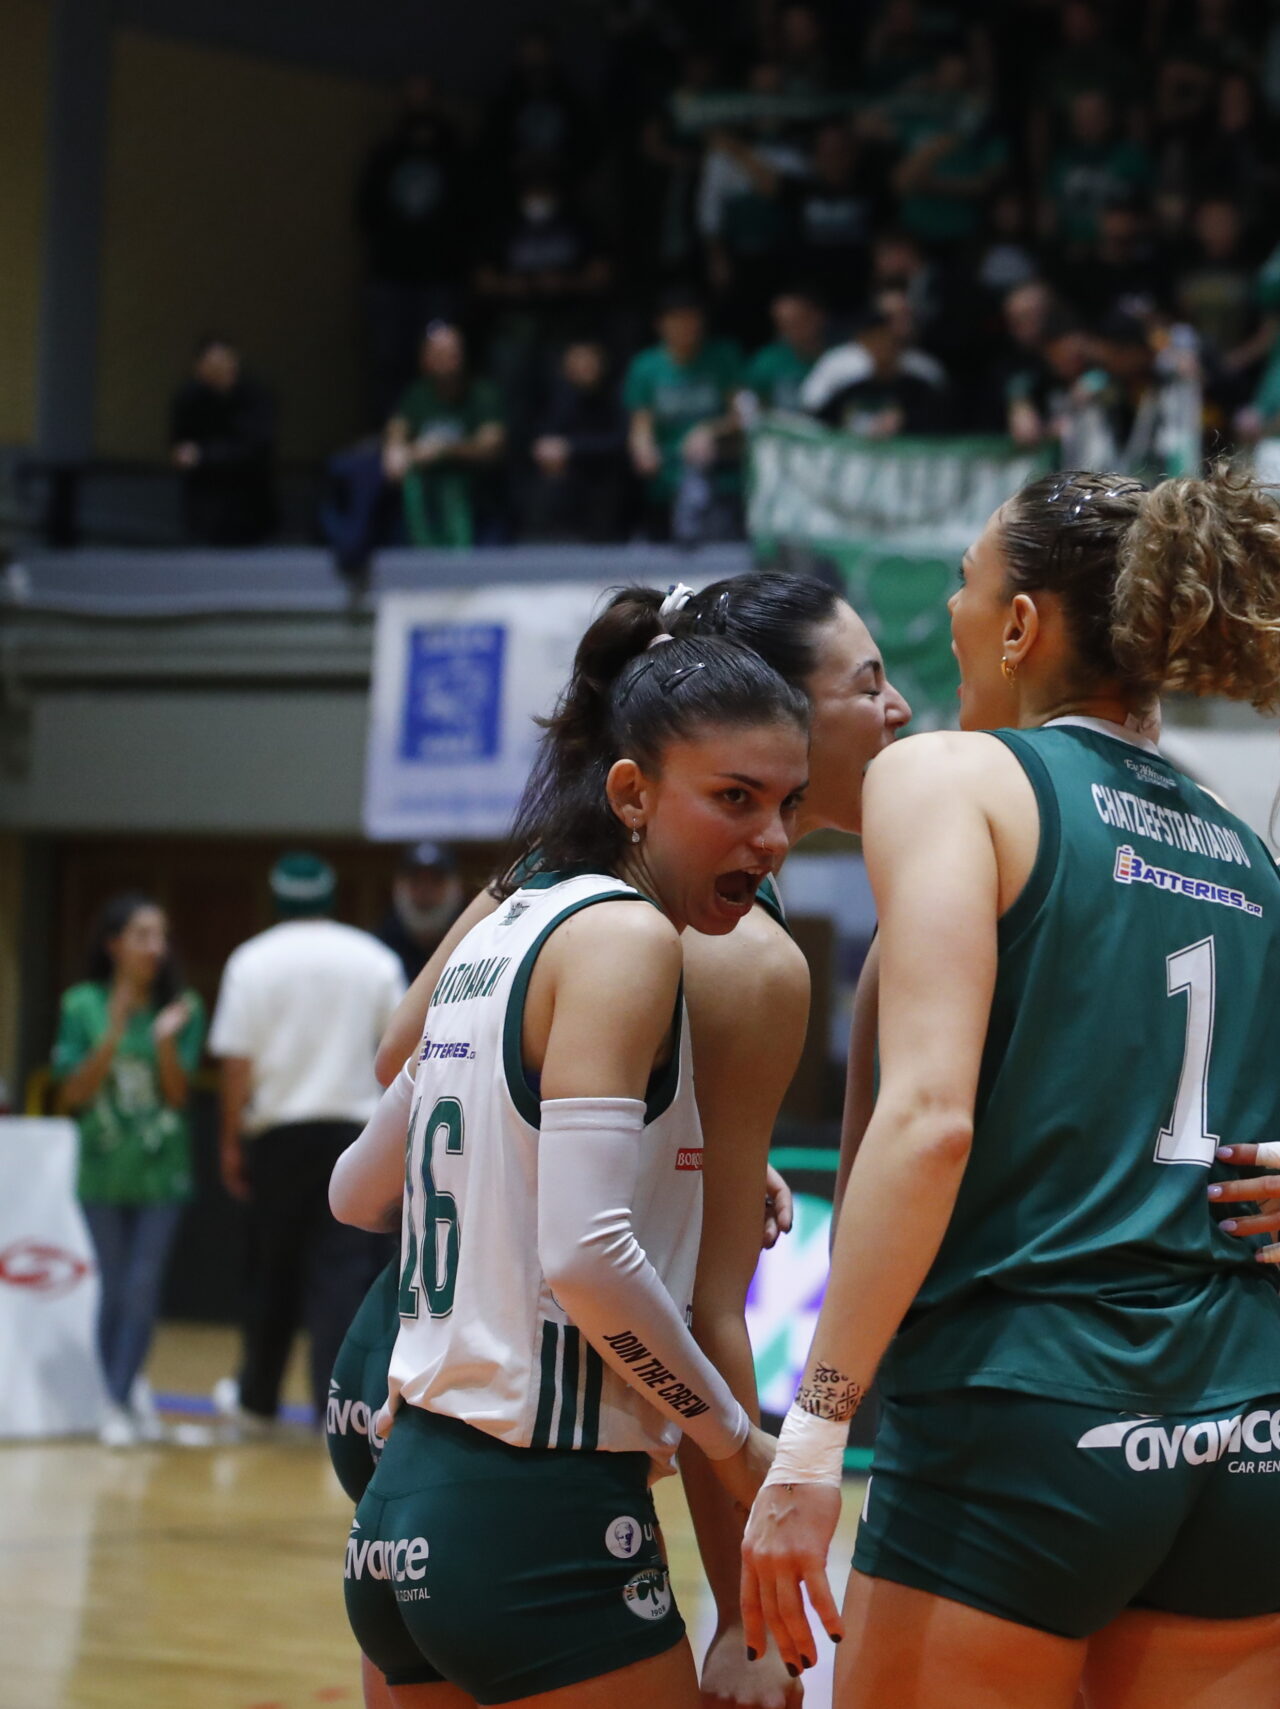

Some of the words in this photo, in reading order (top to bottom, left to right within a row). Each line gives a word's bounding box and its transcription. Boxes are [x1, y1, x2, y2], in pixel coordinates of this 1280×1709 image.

[1091, 783, 1251, 868] CHATZIEFSTRATIADOU
[1117, 849, 1263, 915] BATTERIES.GR
[1153, 934, 1220, 1168] 1
[399, 1096, 464, 1319] 16
[603, 1331, 650, 1363] JOIN
[632, 1358, 676, 1388] THE
[658, 1383, 710, 1418] CREW
[1228, 1460, 1255, 1473] CAR
[344, 1537, 429, 1581] avance
